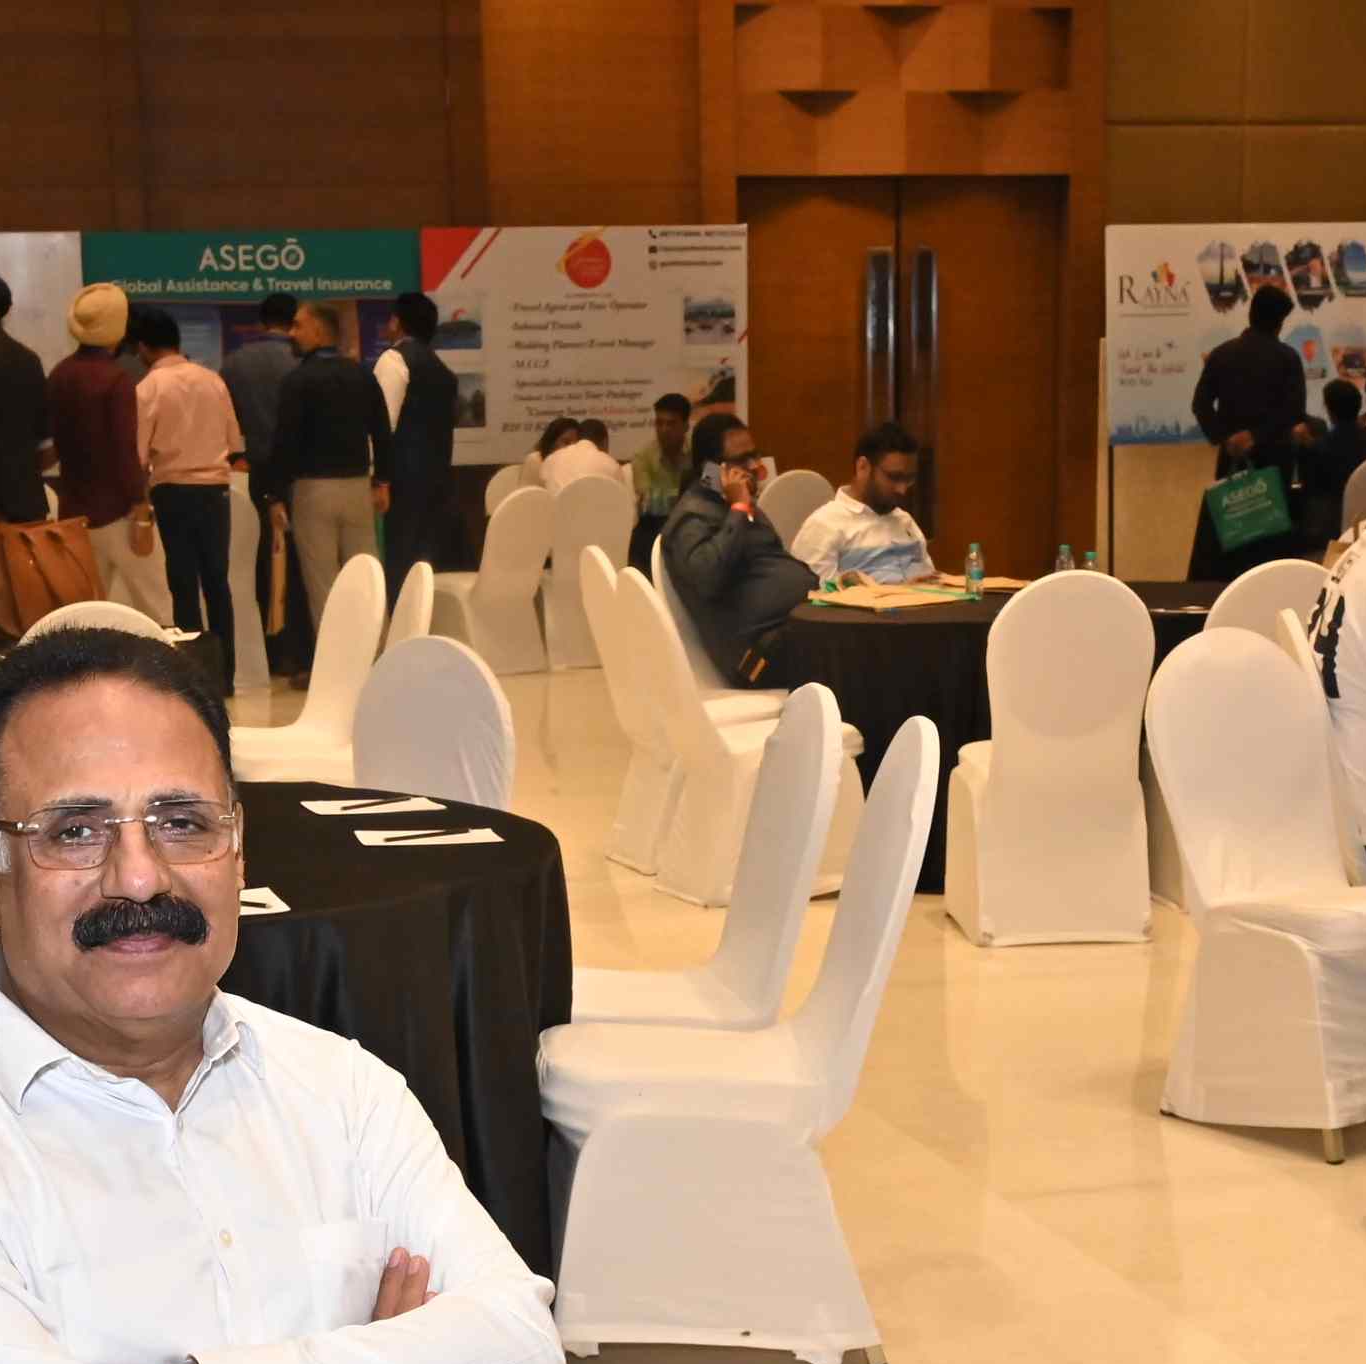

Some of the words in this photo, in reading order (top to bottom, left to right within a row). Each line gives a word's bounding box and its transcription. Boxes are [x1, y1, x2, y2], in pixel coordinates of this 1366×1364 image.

[166, 278, 249, 292] Assistance
[253, 277, 264, 291] &
[267, 277, 314, 291] Travel
[317, 278, 392, 291] Insurance
